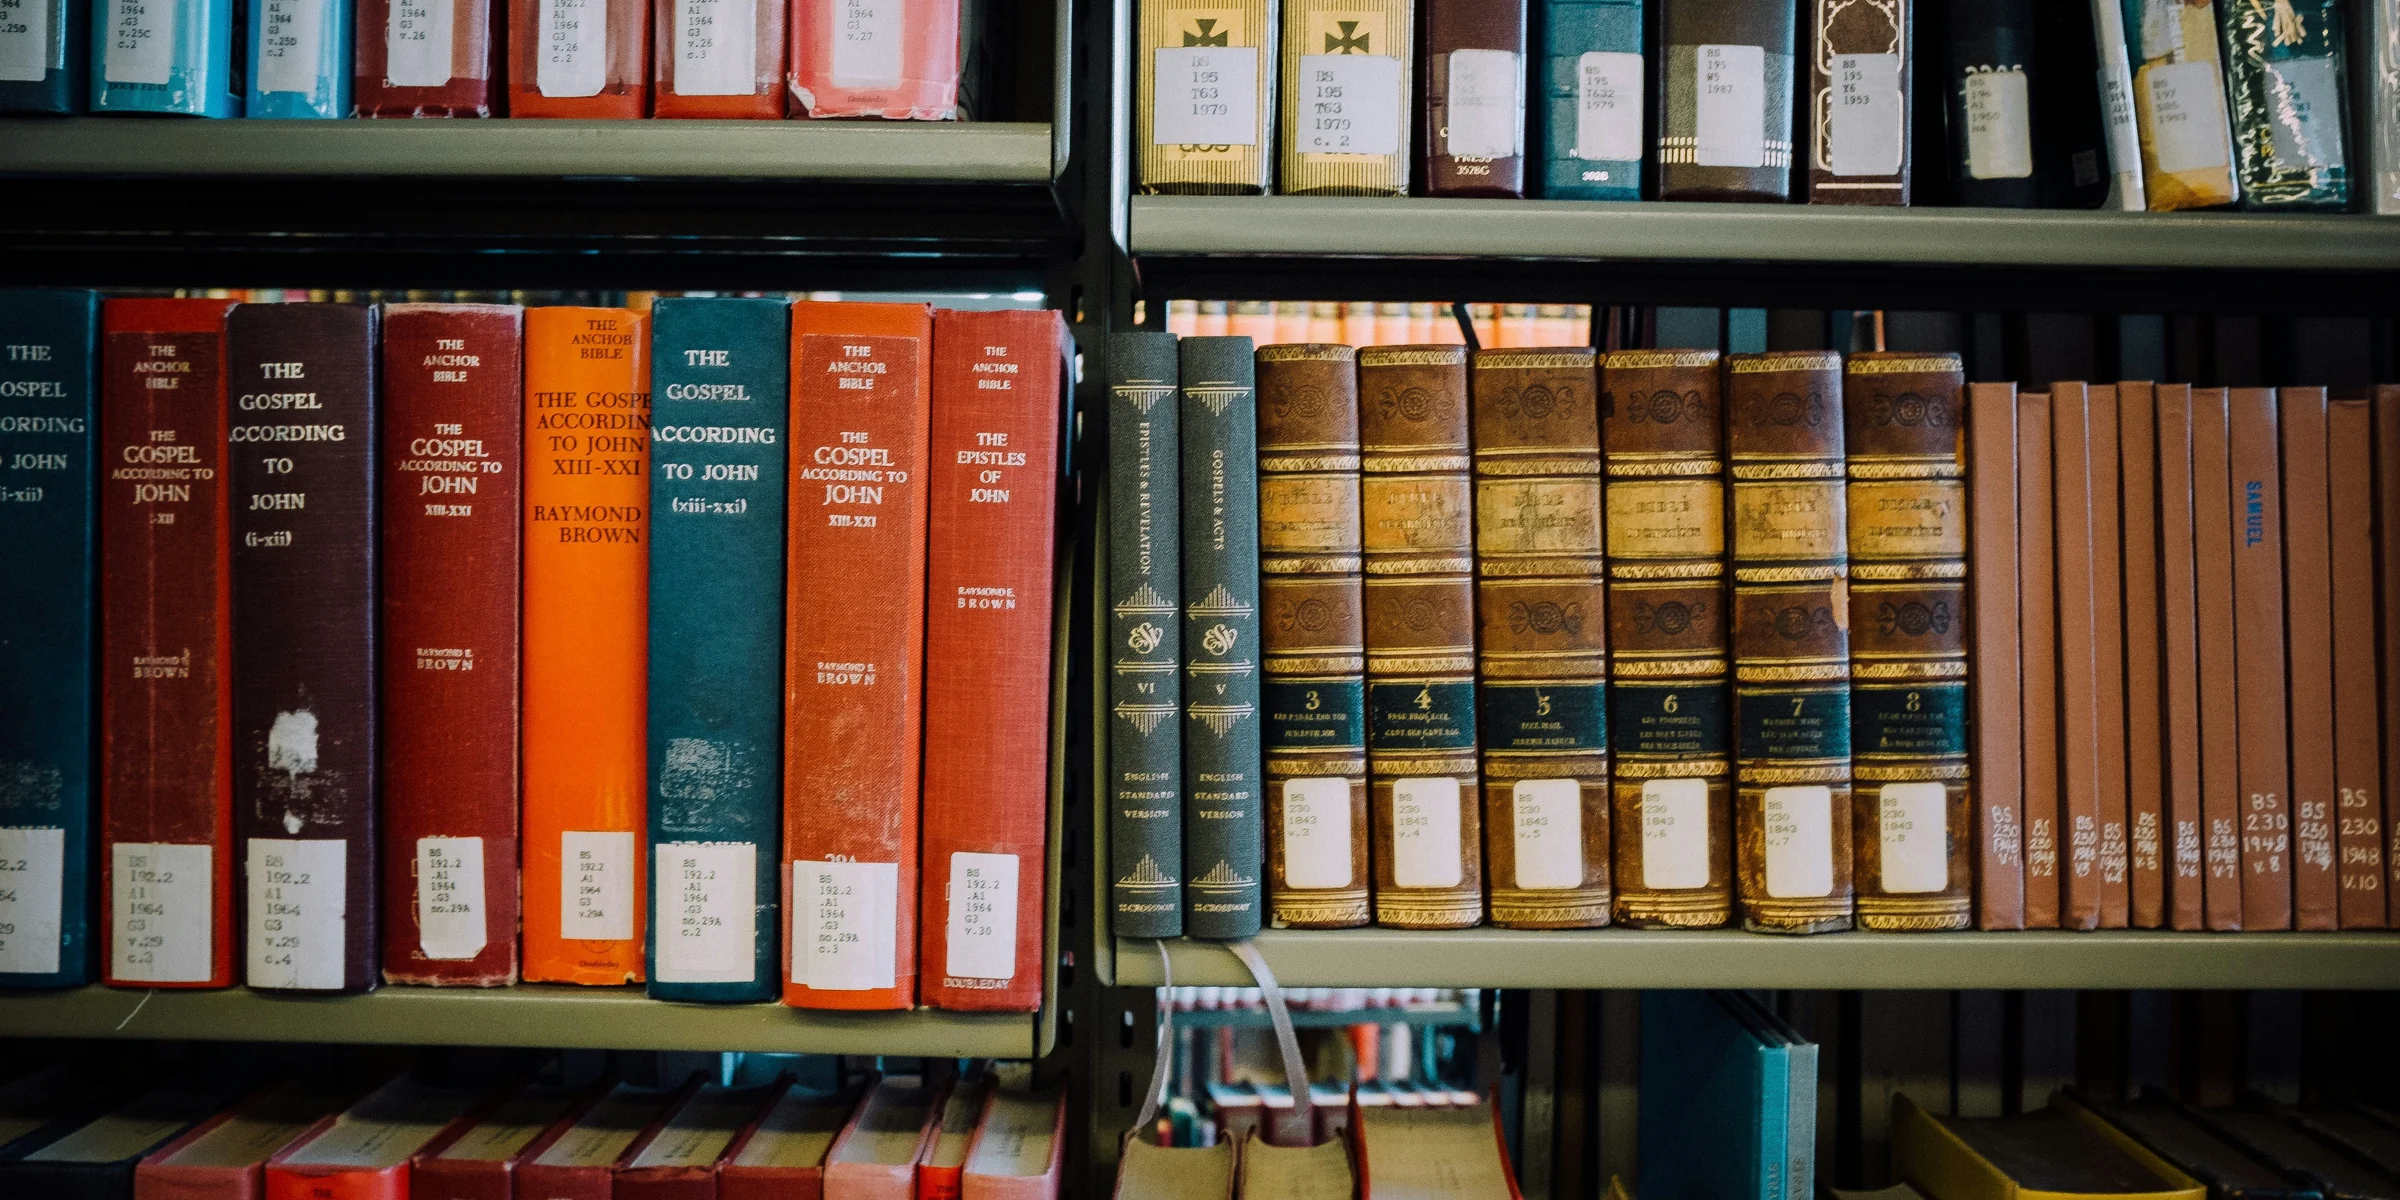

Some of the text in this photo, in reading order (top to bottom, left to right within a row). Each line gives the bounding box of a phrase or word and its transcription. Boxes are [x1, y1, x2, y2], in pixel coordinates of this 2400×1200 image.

[120, 6, 145, 15] 1964
[553, 10, 566, 19] A1
[848, 9, 873, 19] 1964
[553, 21, 578, 30] 1964
[847, 21, 860, 30] G3
[118, 29, 151, 38] v.25C
[552, 32, 565, 41] G3
[847, 32, 873, 41] v.27
[117, 40, 137, 49] c.2
[552, 43, 578, 52] v.26
[688, 39, 713, 48] v.26
[552, 54, 572, 63] c.2
[687, 50, 707, 59] c.3
[1707, 61, 1726, 70] 195
[1192, 71, 1218, 83] 195
[1587, 77, 1608, 86] 195
[1844, 72, 1862, 81] 195
[1191, 87, 1218, 99] T63
[1316, 86, 1343, 98] 195
[1586, 89, 1616, 98] T632
[1586, 101, 1615, 110] 1979
[1843, 96, 1870, 105] 1953
[1191, 103, 1228, 116] 1979
[1315, 102, 1343, 114] T63
[1314, 118, 1351, 130] 1979
[587, 320, 617, 331] THE
[436, 340, 464, 350] THE
[571, 334, 632, 346] ANCHOR
[6, 345, 51, 361] THE
[149, 345, 176, 357] THE
[580, 348, 623, 360] BIBLE
[843, 345, 871, 357] THE
[984, 346, 1007, 357] THE
[423, 355, 480, 367] ANCHOR
[684, 350, 730, 367] THE
[133, 362, 191, 373] ANCHOR
[260, 362, 304, 379] THE
[827, 362, 887, 374] ANCHOR
[971, 363, 1019, 374] ANCHOR
[433, 371, 467, 382] BIBLE
[146, 378, 180, 389] BIBLE
[839, 378, 874, 390] BIBLE
[978, 379, 1012, 390] BIBLE
[666, 383, 751, 401] GOSPEL
[239, 393, 322, 410] GOSPEL
[534, 392, 577, 409] THE
[149, 430, 176, 441] THE
[229, 425, 345, 442] CCORDING
[434, 424, 462, 435] THE
[840, 432, 868, 443] THE
[976, 432, 1008, 447] THE
[410, 439, 489, 458] GOSPEL
[549, 436, 645, 456] TO JOHN
[1139, 422, 1150, 478] EPISTLES
[123, 446, 201, 464] GOSPEL
[814, 447, 895, 467] GOSPEL
[957, 450, 1027, 466] EPISTLES
[11, 454, 68, 470] JOHN
[263, 458, 293, 474] TO
[398, 460, 502, 474] ACCORDING TO
[553, 459, 640, 476] XIII-XXI
[112, 468, 214, 480] ACCORDING TO
[662, 463, 759, 481] TO JOHN
[801, 468, 907, 483] ACCORDING TO
[979, 470, 1002, 484] OF
[1212, 449, 1224, 504] GOSPELS
[418, 475, 478, 496] JOHN
[133, 485, 191, 505] JOHN
[822, 485, 883, 506] JOHN
[968, 488, 1010, 503] JOHN
[250, 493, 305, 510] JOHN
[672, 497, 747, 514] (xiii-xxi)
[425, 504, 472, 517] XIII-XXI
[534, 506, 641, 522] RAYMOND
[2245, 480, 2264, 548] SAMUEL
[828, 514, 877, 528] XIII-XXI
[245, 532, 292, 547] (i-xii)
[560, 527, 640, 543] BROWN
[1139, 493, 1151, 575] REVELATION
[1213, 518, 1225, 551] ACTS
[957, 598, 1016, 610] BROWN
[417, 658, 473, 671] BROWN
[134, 667, 189, 678] BROWN
[817, 672, 876, 685] BROWN
[1137, 682, 1155, 694] VI
[1216, 684, 1227, 695] V
[1306, 690, 1321, 710] 3
[1414, 688, 1433, 710] 4
[1663, 693, 1679, 714] 6
[1906, 691, 1921, 712] 8
[1536, 695, 1551, 716] 5
[1791, 697, 1805, 717] 7
[1124, 772, 1169, 782] ENGLISH
[1199, 773, 1244, 782] ENGLISH
[1119, 791, 1175, 800] STANDARD
[1195, 791, 1249, 800] STANDARD
[2340, 788, 2368, 808] BS
[2251, 793, 2278, 811] BS
[1124, 810, 1170, 819] VERSION
[1199, 810, 1245, 819] VERSION
[2246, 813, 2289, 831] 230
[2341, 818, 2379, 835] 230
[2243, 834, 2289, 853] 1948
[2342, 847, 2380, 866] 1948
[683, 870, 716, 880] 192.2
[966, 868, 980, 878] BS
[819, 875, 832, 884] BS
[967, 880, 1000, 889] 192.2
[820, 886, 852, 896] 192.2
[967, 891, 985, 900] .A1
[683, 893, 708, 902] 1964
[820, 898, 838, 907] .A1
[966, 903, 992, 912] 1964
[820, 909, 845, 919] 1964
[965, 915, 978, 924] G3
[820, 921, 838, 931] .G3
[682, 928, 701, 937] c.2
[818, 933, 859, 943] no.29A
[818, 944, 839, 954] c.3
[265, 954, 291, 966] c.4
[943, 978, 1009, 990] DOUBLEDAY
